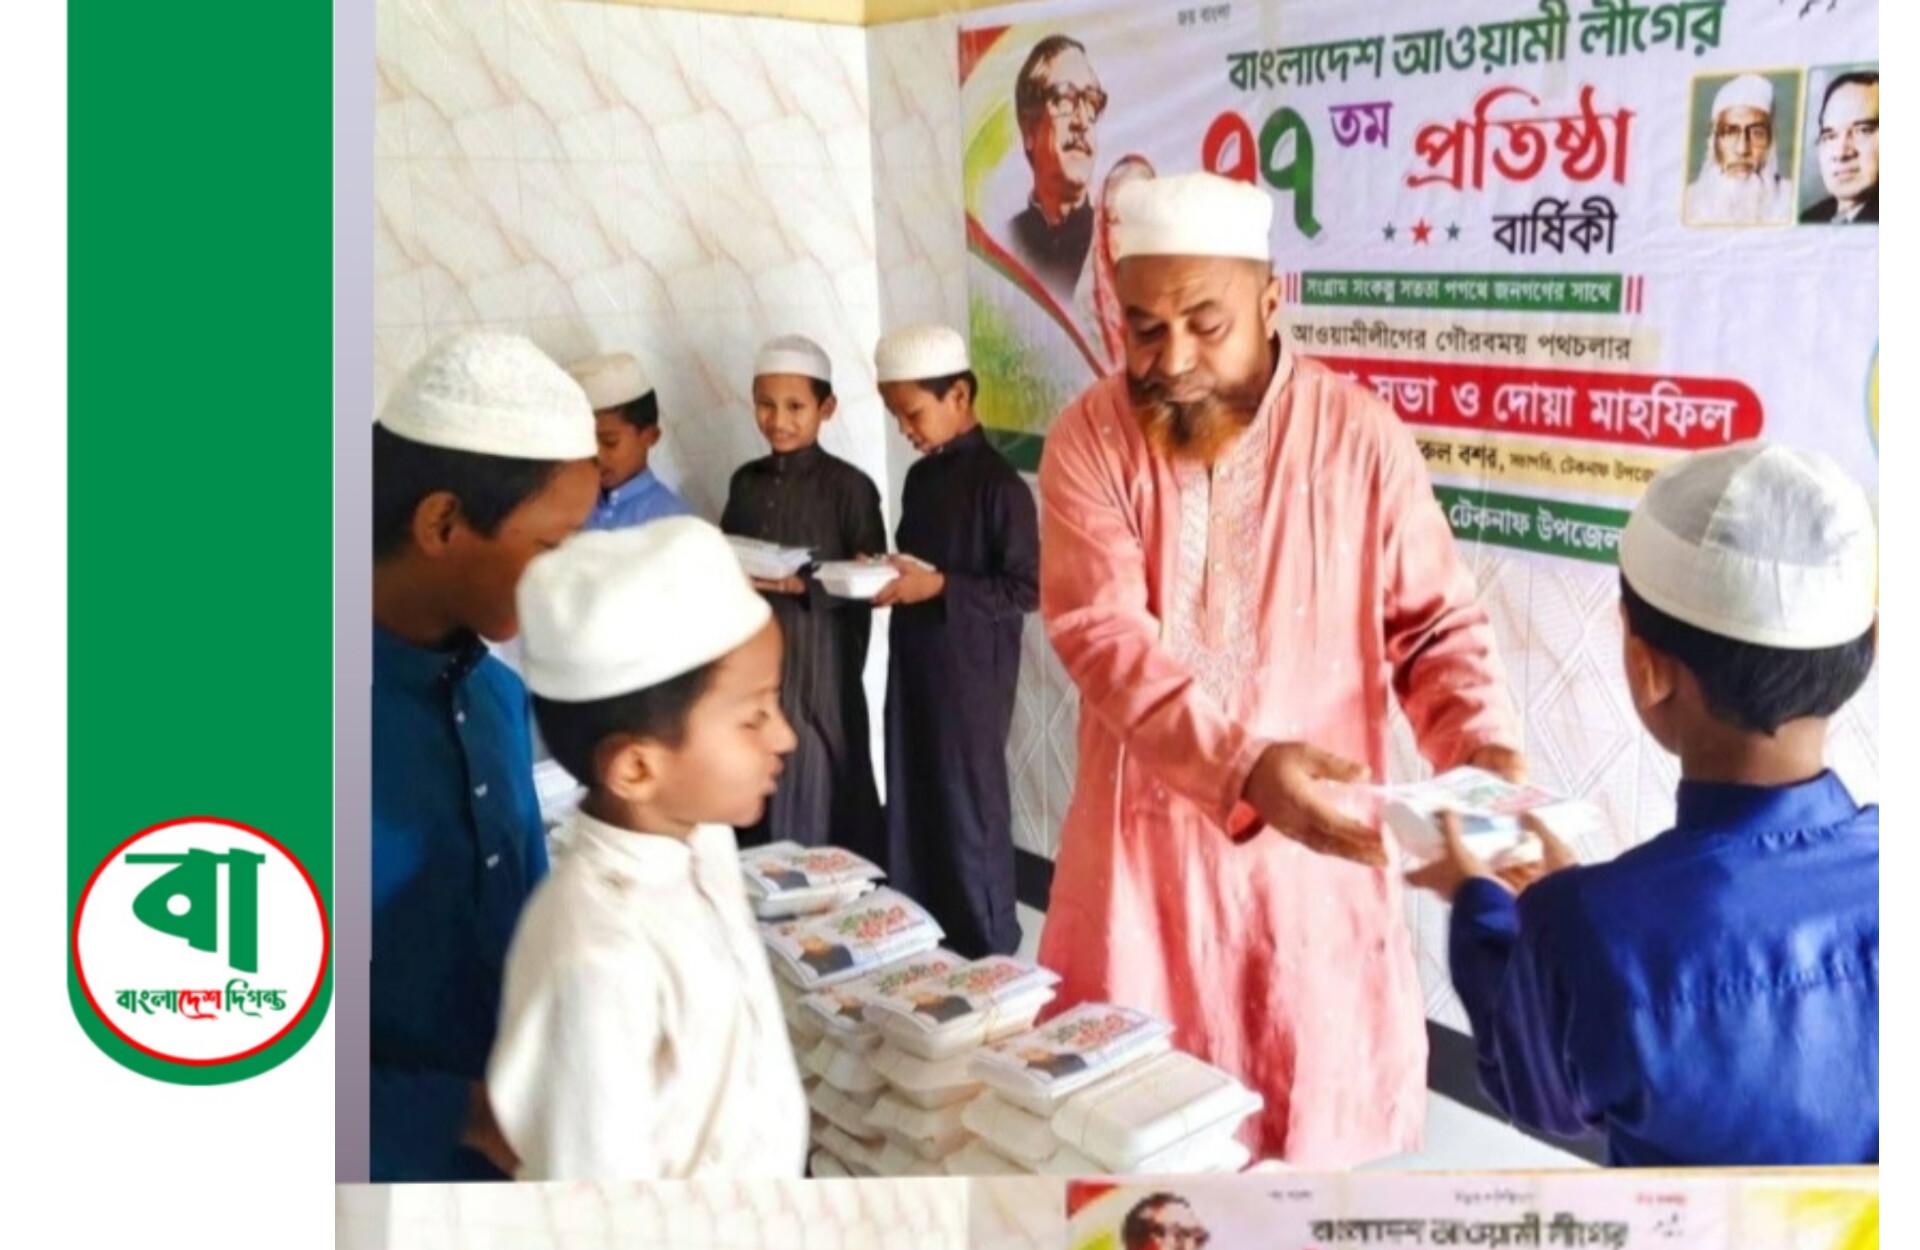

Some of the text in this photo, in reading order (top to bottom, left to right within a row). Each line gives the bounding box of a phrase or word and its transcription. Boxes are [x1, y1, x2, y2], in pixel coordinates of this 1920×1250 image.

[1226, 0, 1729, 92] বাংলাদেশ আওয়ামী লীগের
[1328, 101, 1394, 149] তম
[1406, 83, 1636, 192] প্রতিষ্ঠা
[1492, 195, 1619, 256] বার্ষিকী
[1435, 324, 1528, 355] গৌরবময়
[1537, 332, 1632, 361] পথচলার
[1451, 381, 1480, 418] ও
[1493, 382, 1576, 428] দোয়া
[1588, 380, 1738, 443] মাহফিল
[1450, 496, 1623, 552] টেকনাফ উপজেল
